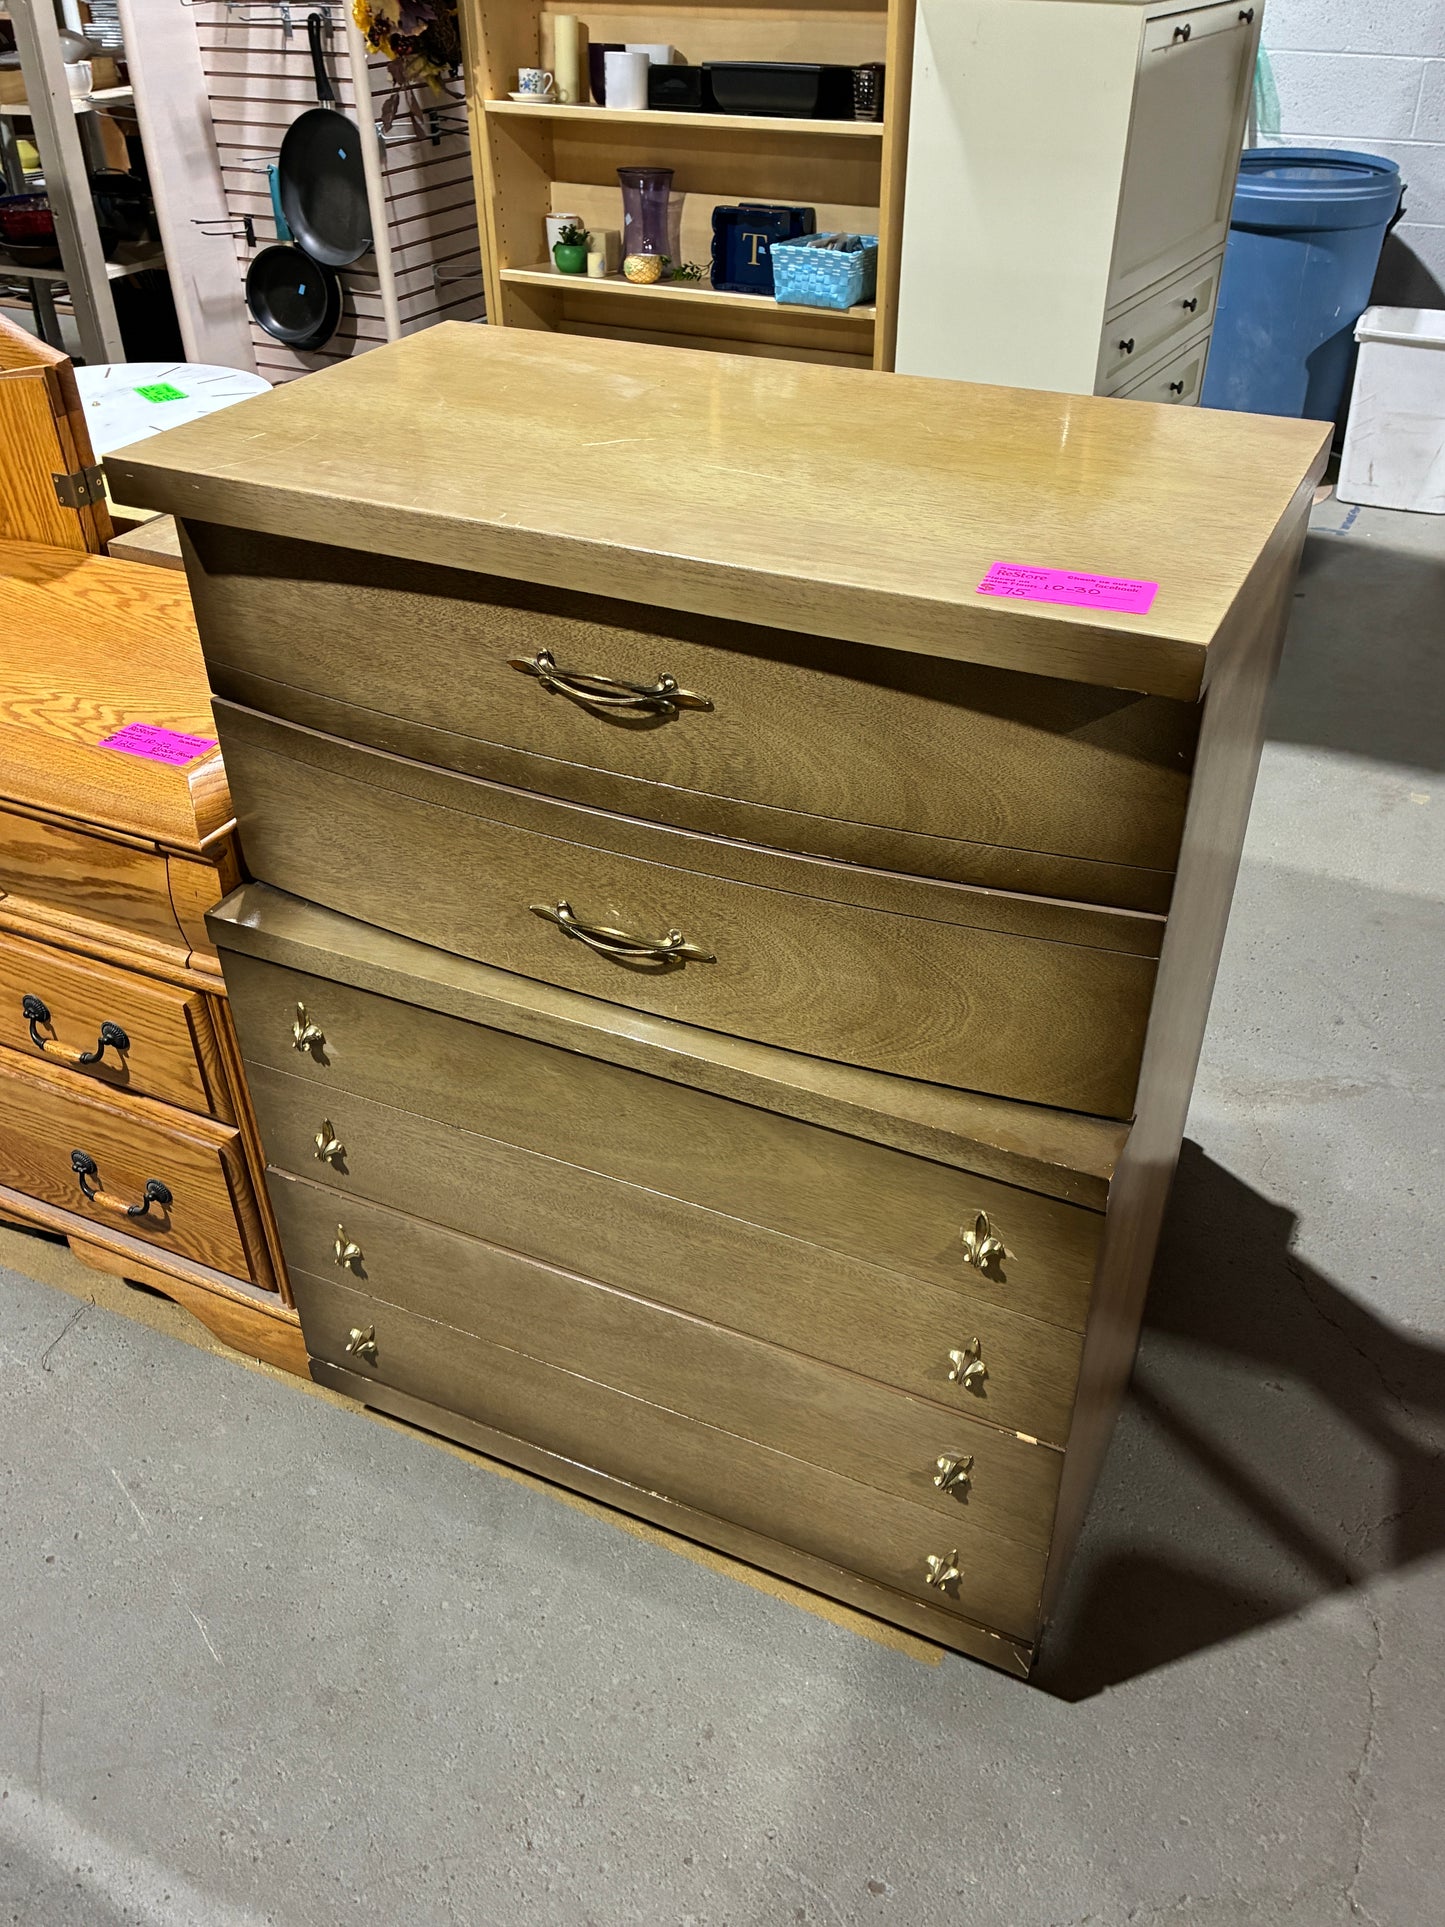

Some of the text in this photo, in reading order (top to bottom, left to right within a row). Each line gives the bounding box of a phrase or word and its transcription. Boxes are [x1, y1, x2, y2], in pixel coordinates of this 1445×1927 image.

[742, 232, 768, 266] T
[997, 569, 1048, 581] ReStore
[1094, 583, 1140, 593] facebook
